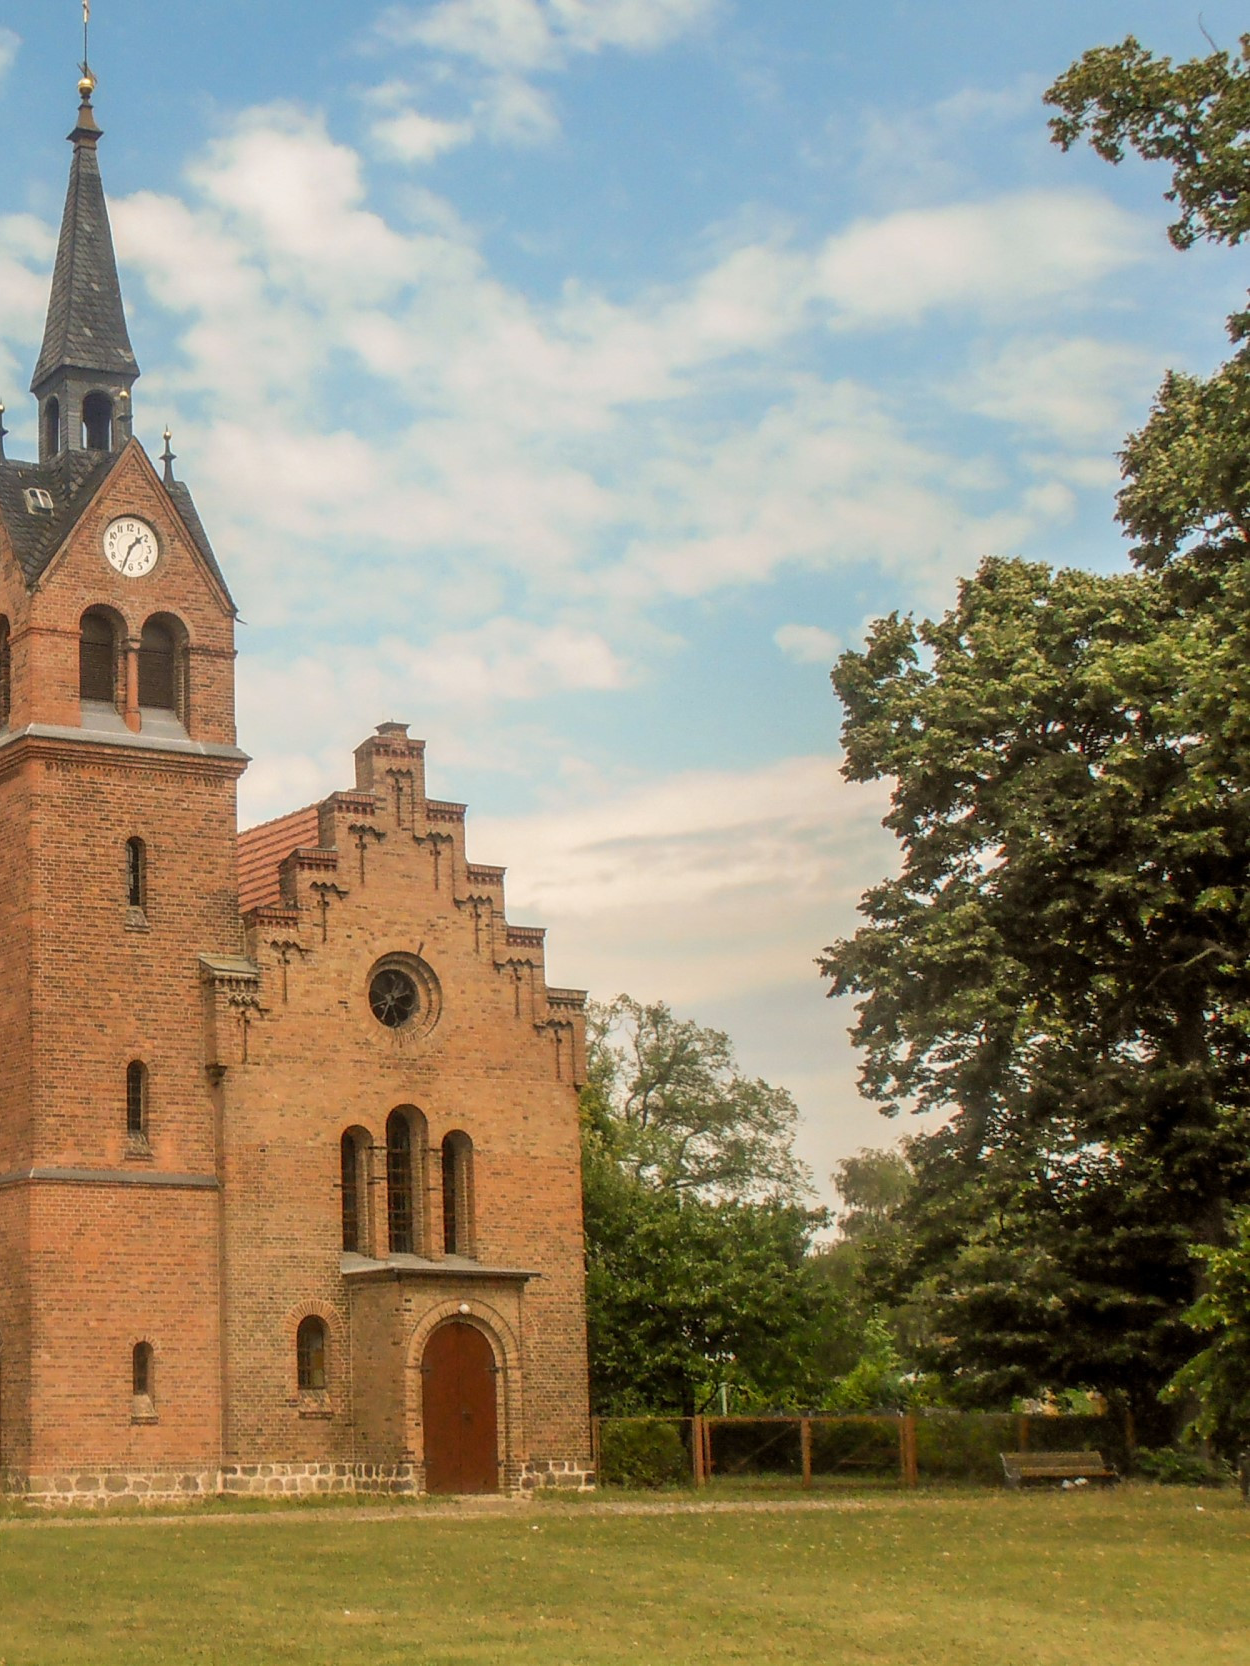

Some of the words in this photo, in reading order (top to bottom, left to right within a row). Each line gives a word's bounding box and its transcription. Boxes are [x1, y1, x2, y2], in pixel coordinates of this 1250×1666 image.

[117, 524, 123, 533] 11
[126, 524, 134, 532] 12
[110, 532, 117, 540] 10
[144, 534, 148, 542] 2
[109, 541, 114, 550] 9
[146, 546, 152, 554] 3
[118, 560, 122, 568] 7
[128, 563, 133, 572] 6
[138, 562, 142, 570] 5
